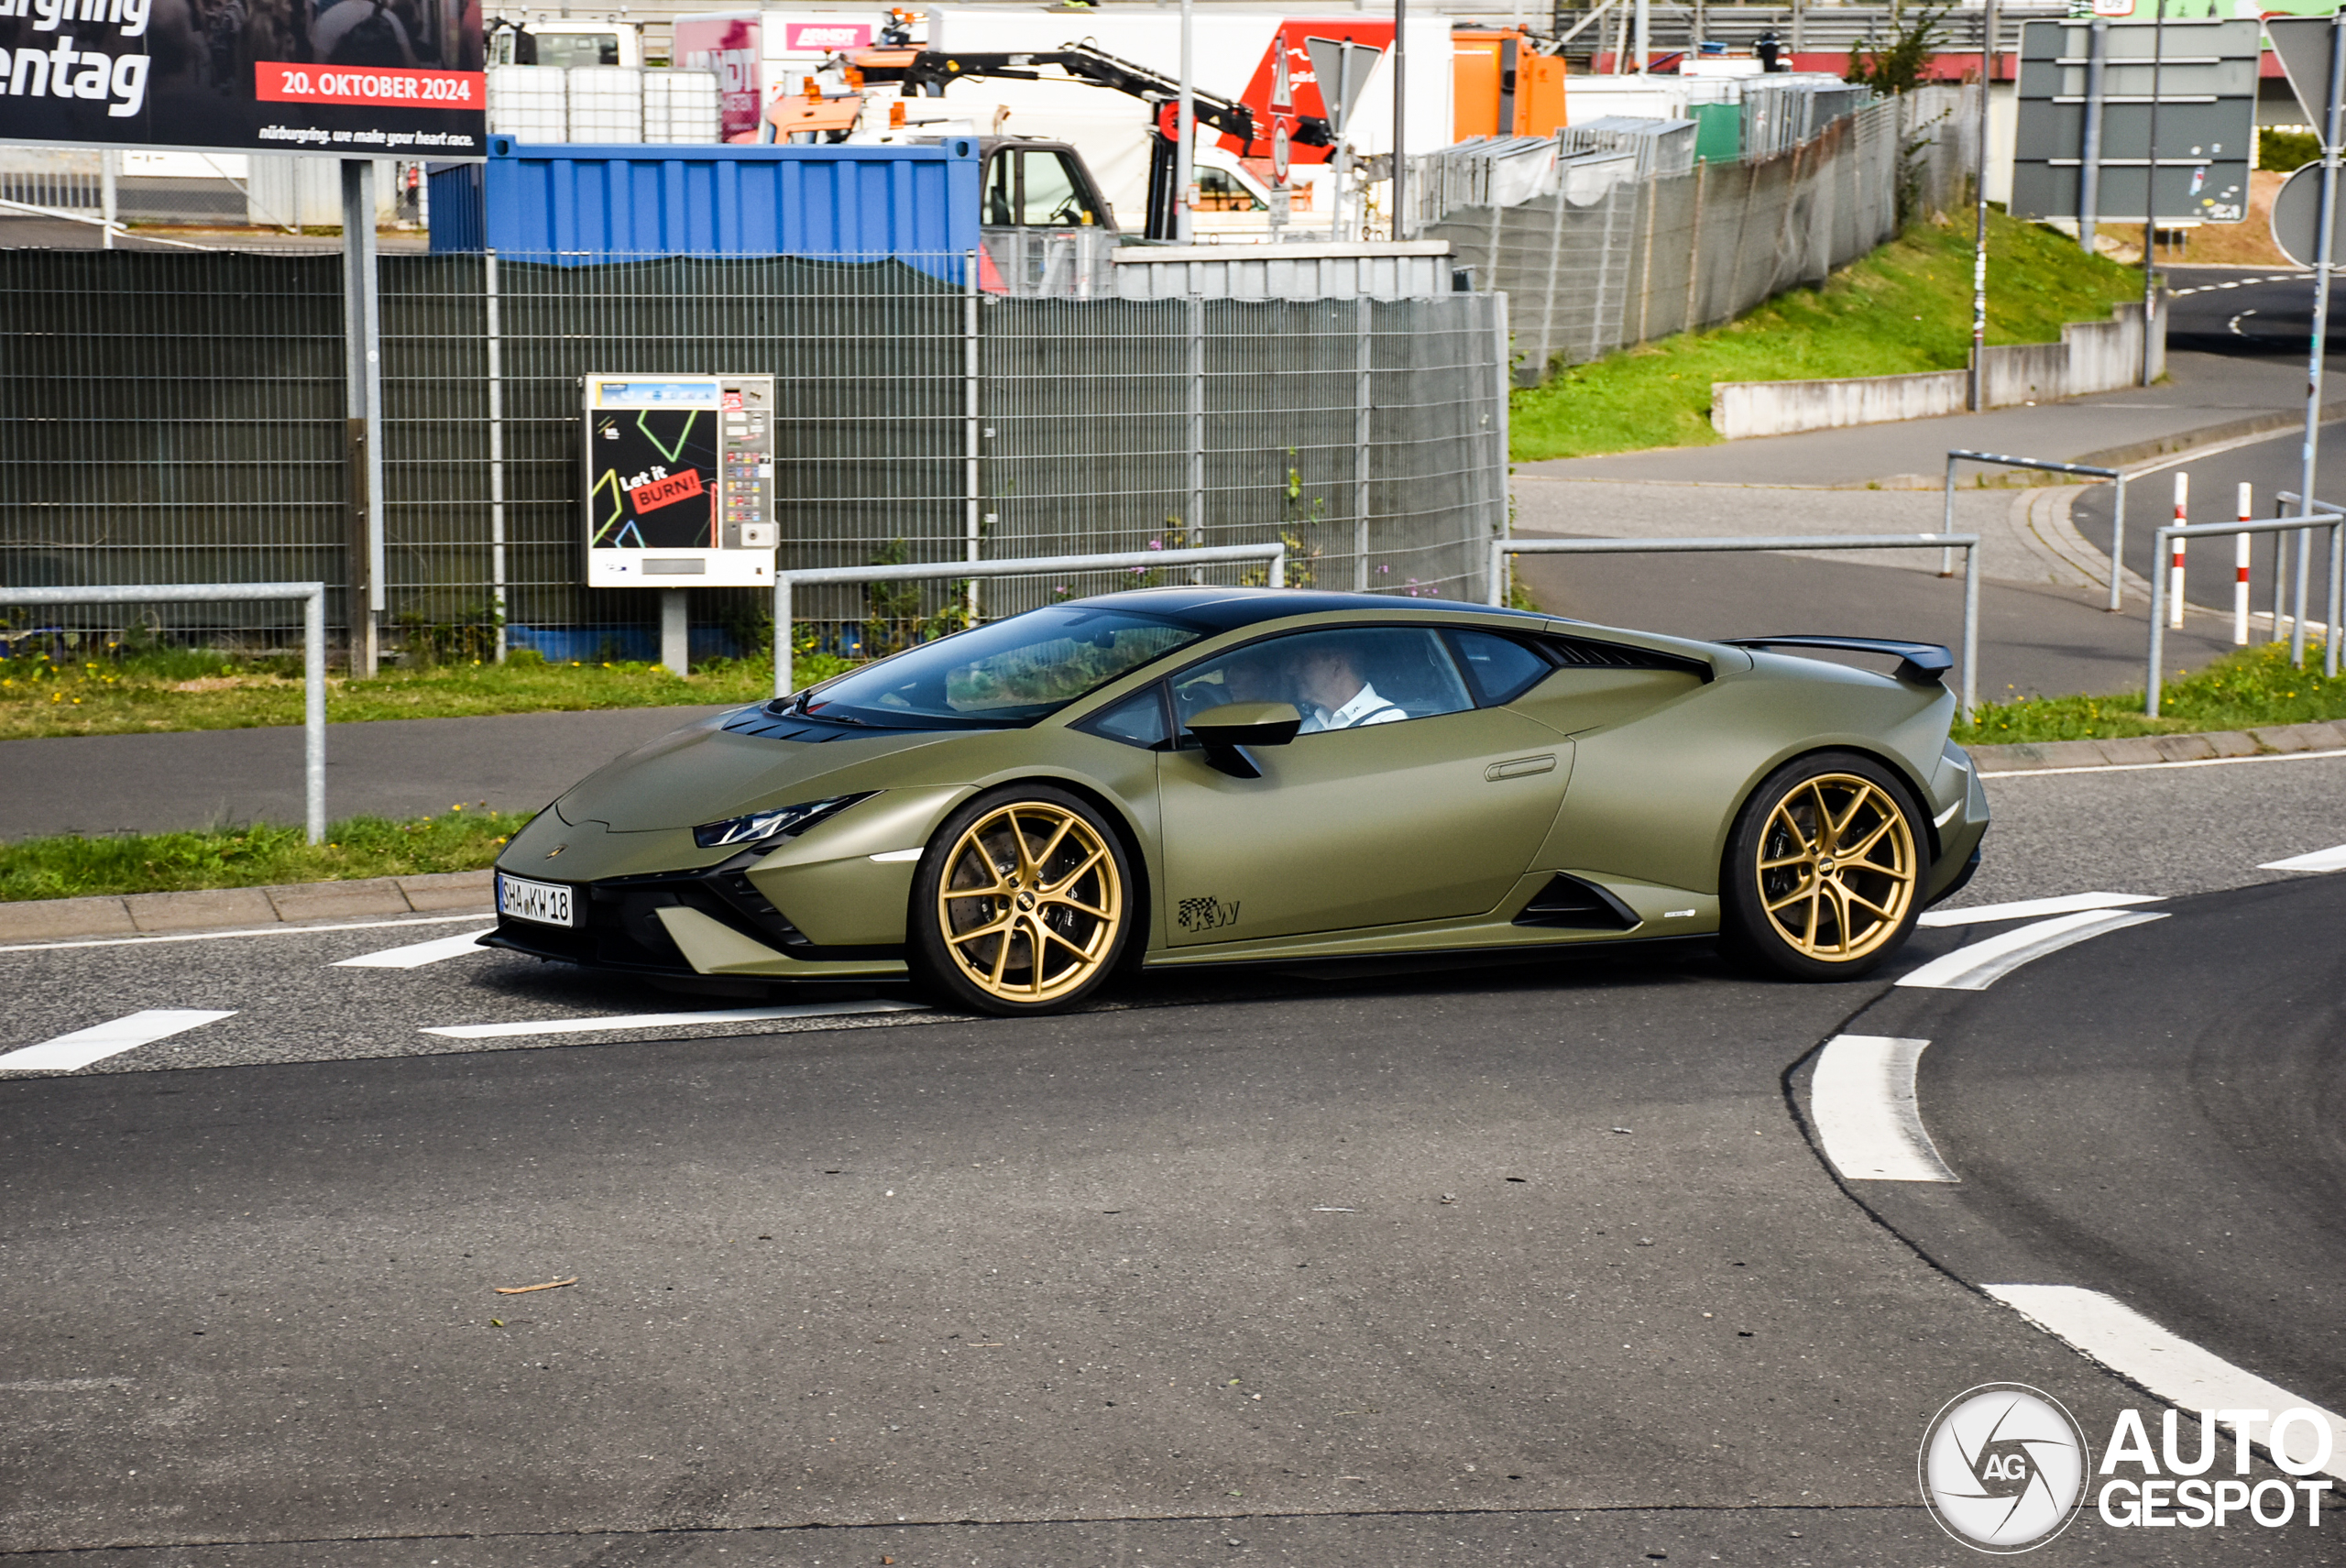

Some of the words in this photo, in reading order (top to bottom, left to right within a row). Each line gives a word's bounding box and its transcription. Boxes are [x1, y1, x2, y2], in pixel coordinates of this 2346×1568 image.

[795, 27, 859, 43] ARNDT
[280, 71, 315, 94] 20.
[318, 73, 419, 99] OKTOBER
[421, 77, 471, 101] 2024
[258, 125, 331, 145] nürburgring.
[333, 130, 353, 142] we
[353, 128, 386, 144] make
[386, 132, 415, 147] your
[414, 130, 447, 145] heart
[446, 135, 475, 147] race.
[619, 471, 652, 492] Let
[650, 466, 669, 481] it
[638, 476, 696, 506] BURN!
[503, 881, 522, 913] SHA
[530, 887, 546, 918] KW
[550, 891, 569, 921] 18
[1189, 900, 1240, 933] KW
